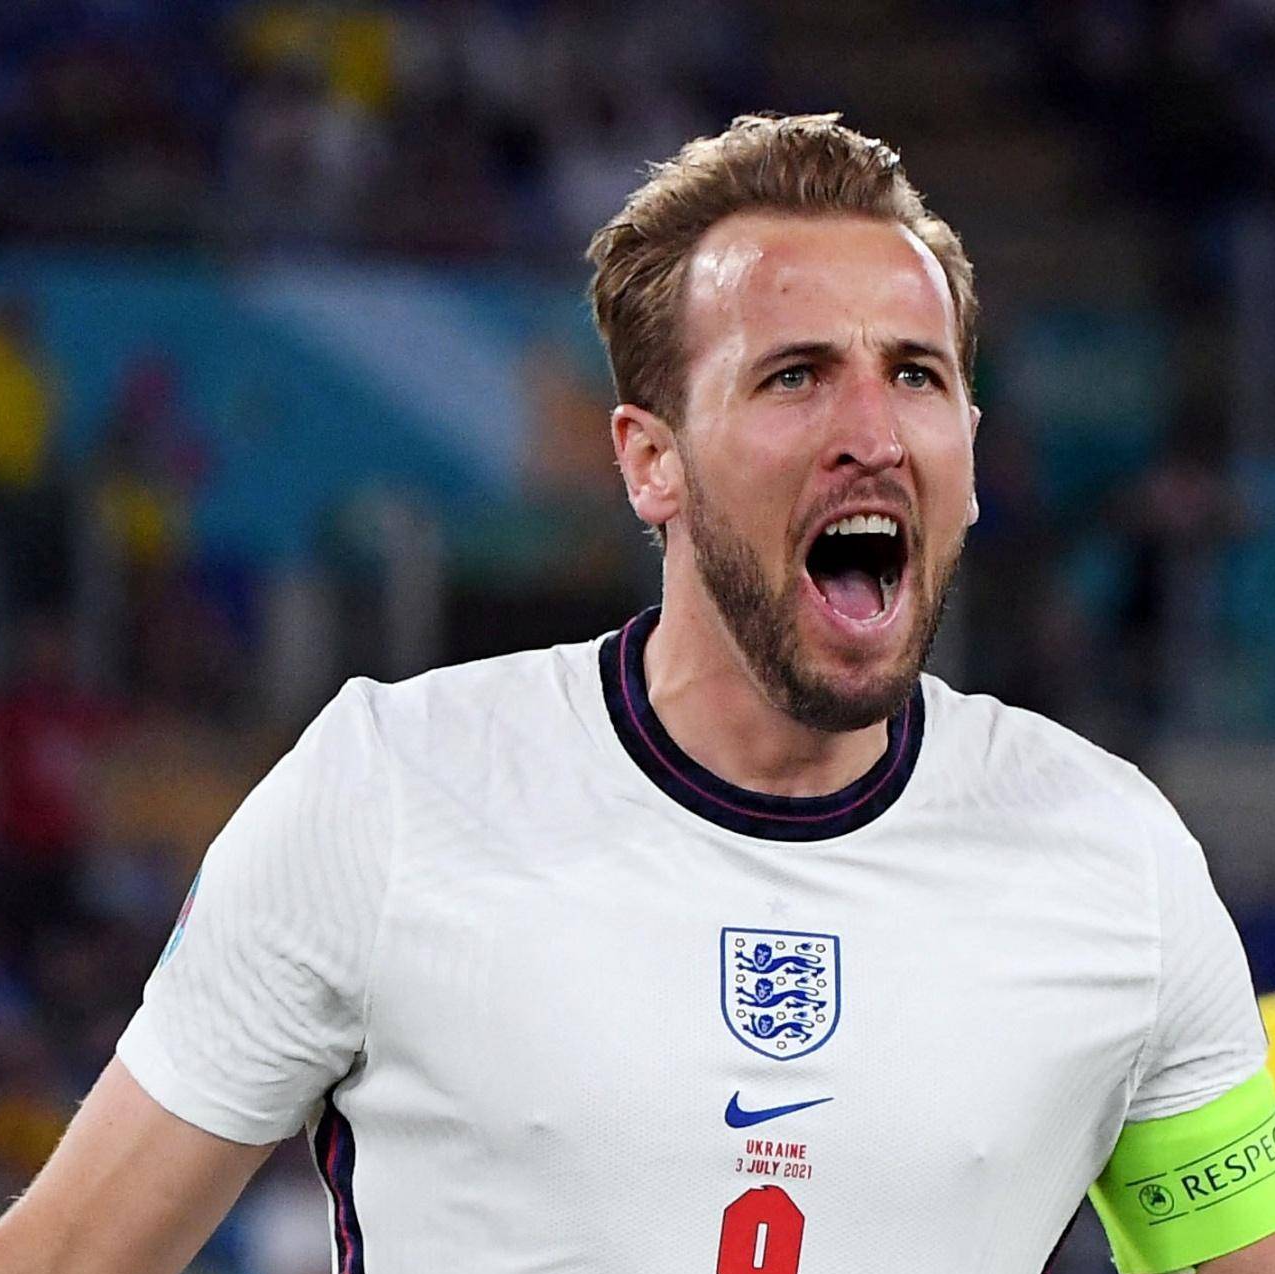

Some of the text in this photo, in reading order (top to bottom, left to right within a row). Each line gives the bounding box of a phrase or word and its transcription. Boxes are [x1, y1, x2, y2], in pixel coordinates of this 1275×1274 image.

[746, 1139, 807, 1160] UKRAINE
[735, 1158, 813, 1180] 3 JULY 2021
